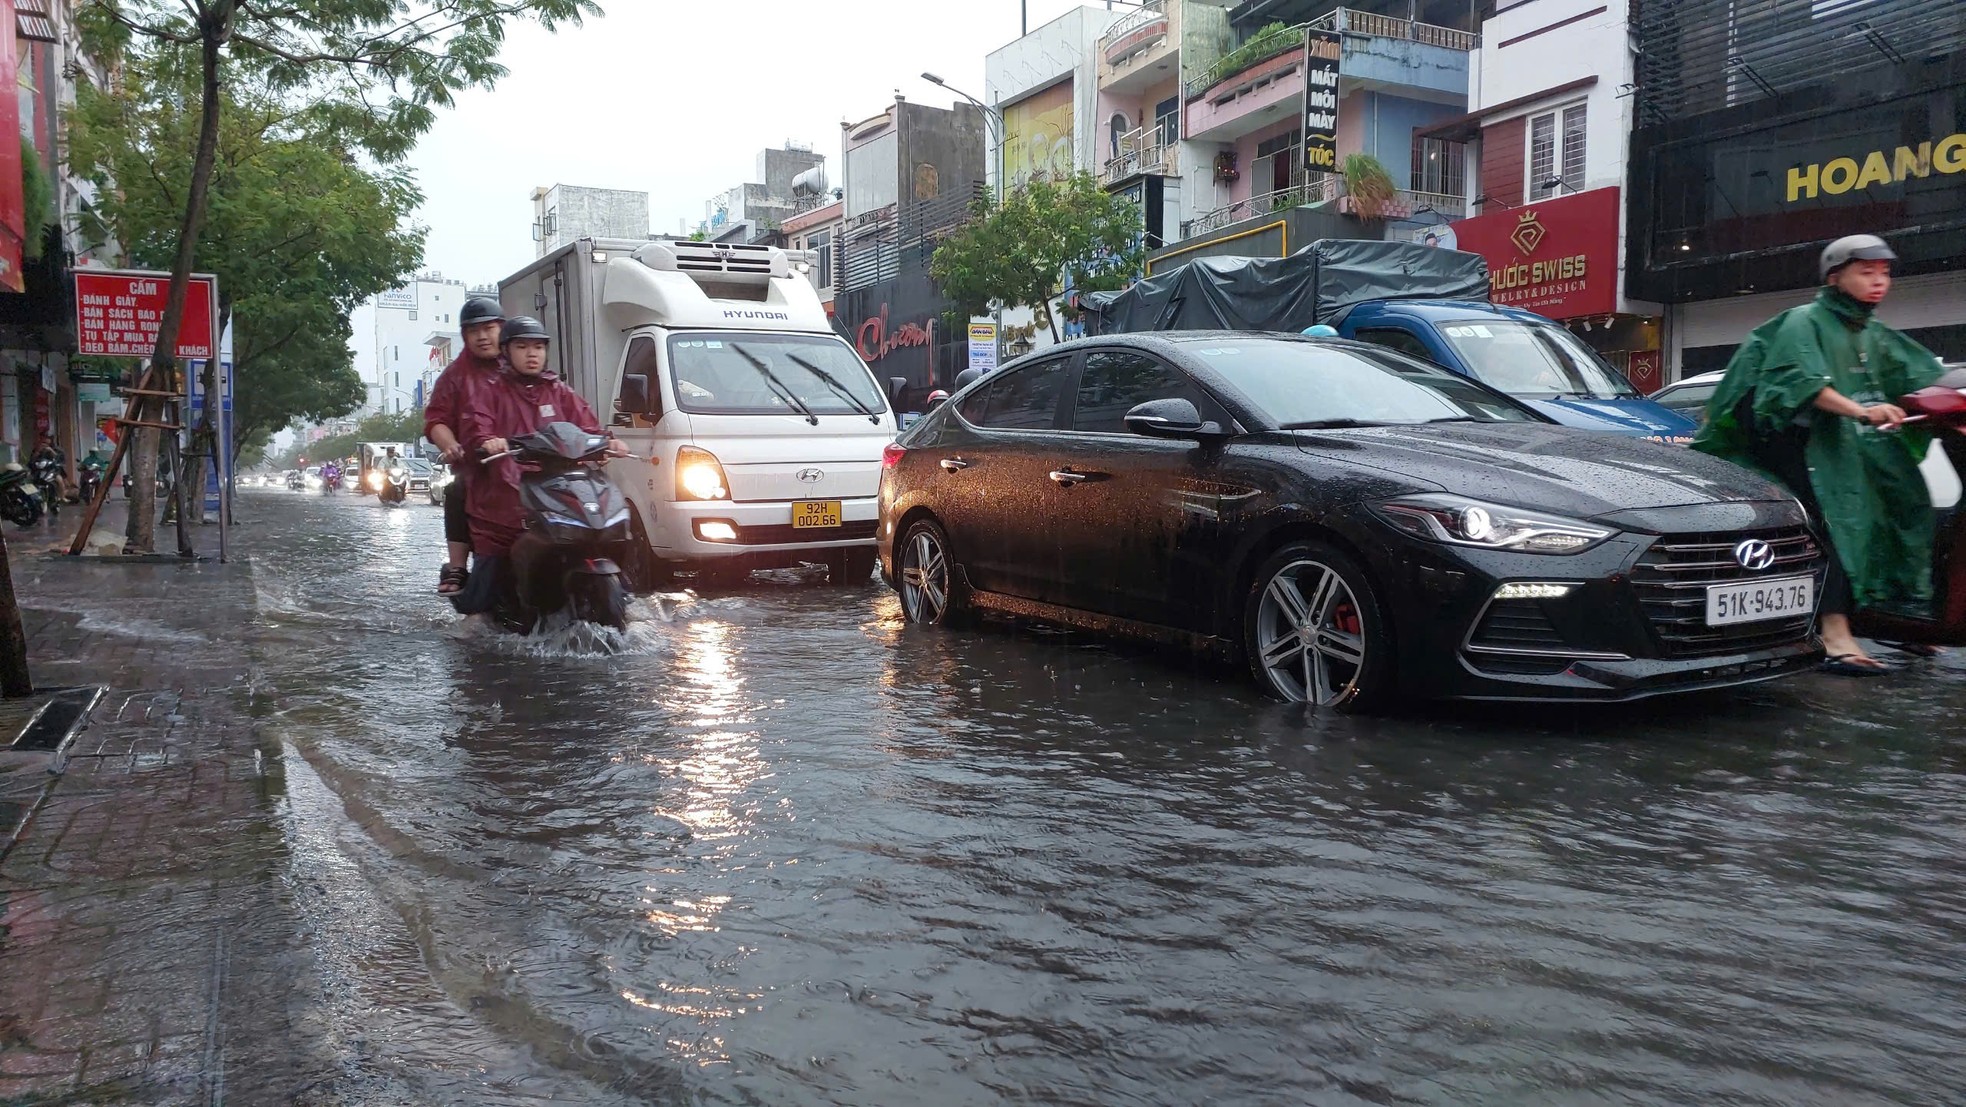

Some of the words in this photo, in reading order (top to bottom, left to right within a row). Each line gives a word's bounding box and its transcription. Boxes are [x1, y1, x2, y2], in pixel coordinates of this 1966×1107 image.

[1310, 89, 1336, 109] MÔI
[1308, 110, 1336, 130] MÀY
[1307, 143, 1335, 167] TÓC
[1787, 133, 1966, 202] HOANG
[1489, 256, 1529, 291] HƯỚC
[1532, 254, 1586, 284] SWISS
[129, 278, 157, 295] CẤM
[108, 308, 133, 319] SÁCH
[138, 309, 156, 320] BÁO
[723, 310, 789, 320] HYUNDAI
[140, 321, 162, 332] RON
[123, 332, 144, 343] MUA
[179, 344, 208, 355] KHÁCH
[806, 502, 828, 514] 92H
[798, 514, 836, 526] 002.66
[1717, 585, 1806, 618] 51K-943.76
